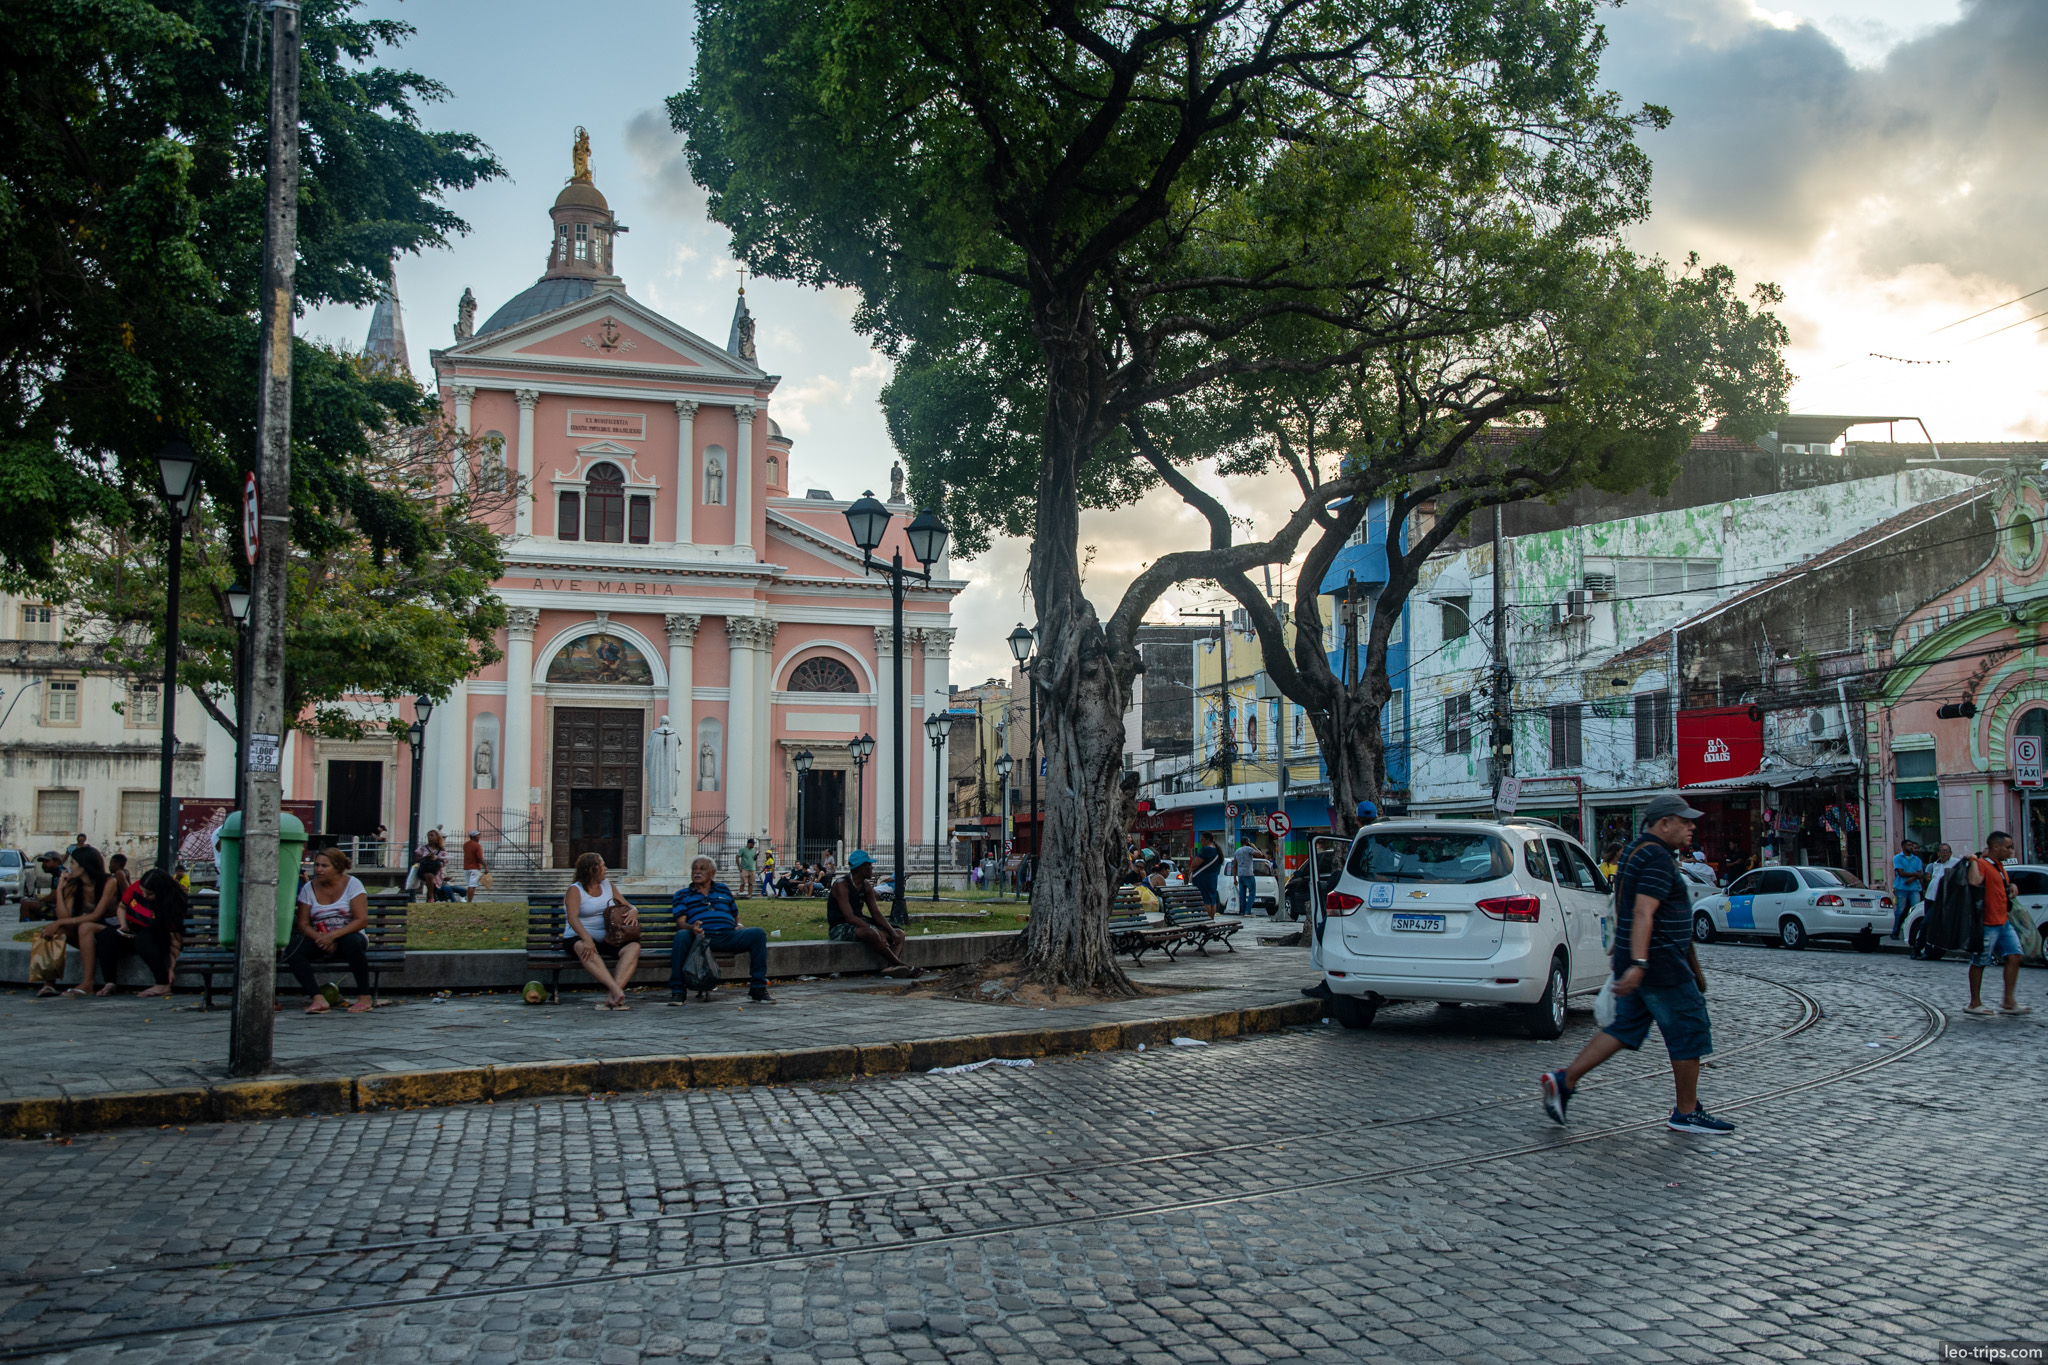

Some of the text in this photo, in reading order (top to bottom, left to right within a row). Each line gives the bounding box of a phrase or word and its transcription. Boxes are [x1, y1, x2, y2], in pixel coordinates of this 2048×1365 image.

[533, 578, 674, 595] AVE MARIA
[2023, 745, 2031, 756] E
[257, 755, 272, 764] 99
[2018, 766, 2040, 777] TÁXI
[1274, 816, 1284, 831] E
[1396, 919, 1439, 930] SNP4J75
